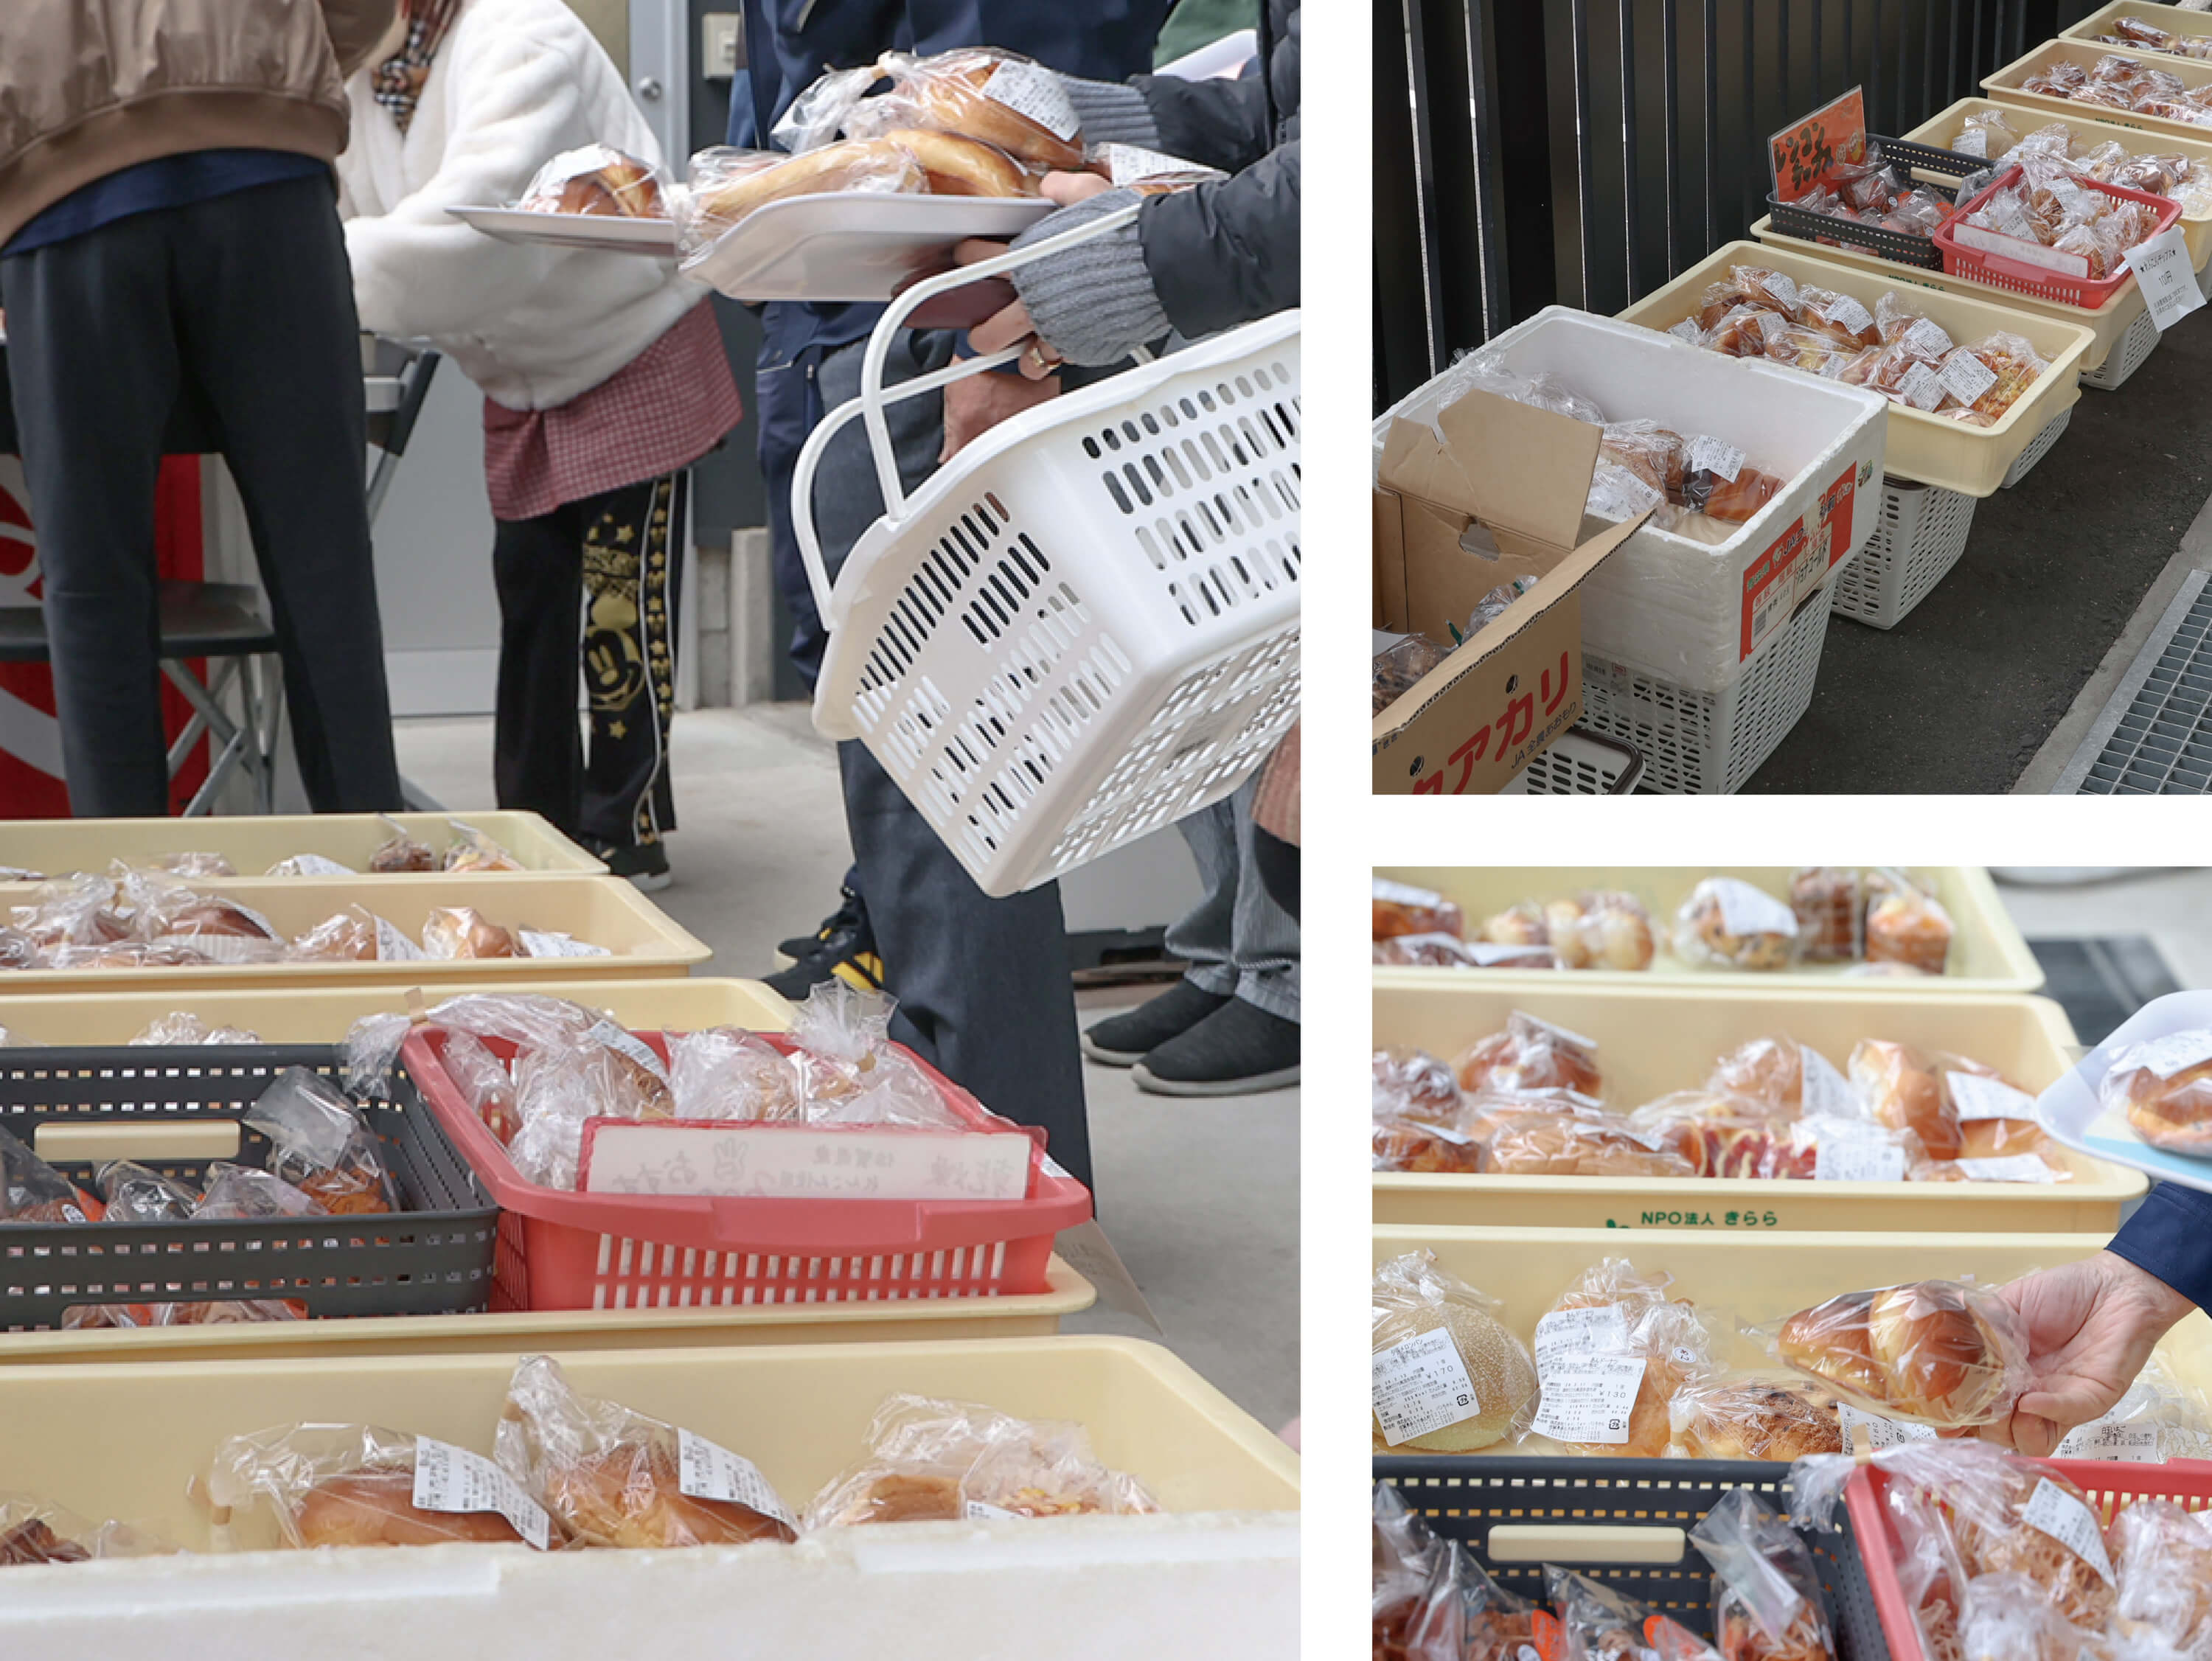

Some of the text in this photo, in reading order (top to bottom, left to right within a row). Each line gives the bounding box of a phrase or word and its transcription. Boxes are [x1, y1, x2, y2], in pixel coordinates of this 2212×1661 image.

[1641, 1211, 1778, 1226] NPO法人 きらら
